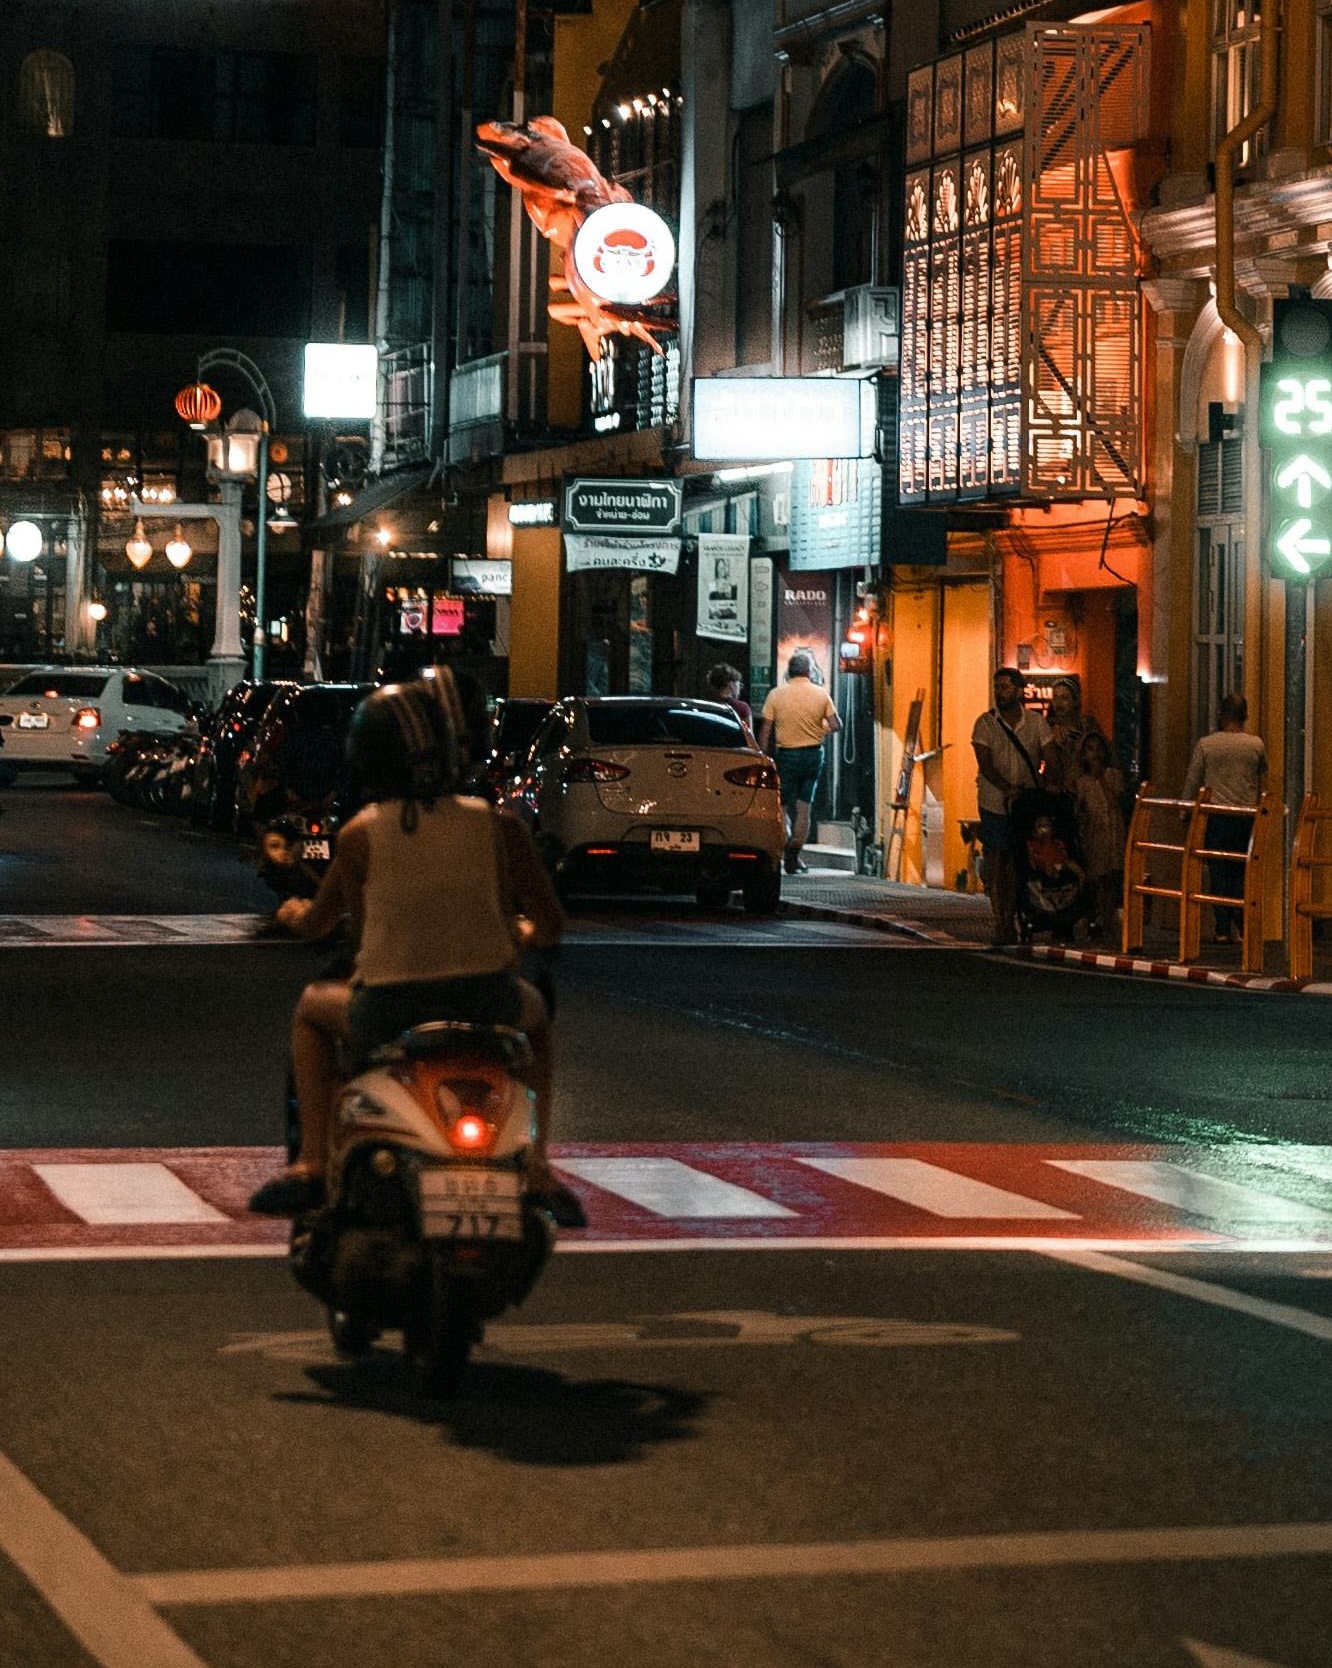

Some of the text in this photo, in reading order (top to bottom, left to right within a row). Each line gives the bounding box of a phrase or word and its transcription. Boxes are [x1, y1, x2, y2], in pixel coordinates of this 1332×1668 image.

[578, 492, 668, 509] งามไทยนาฬิกา
[784, 589, 827, 601] RADO
[1024, 683, 1054, 700] ร้าน
[680, 832, 693, 843] 23
[446, 1215, 499, 1239] 717
